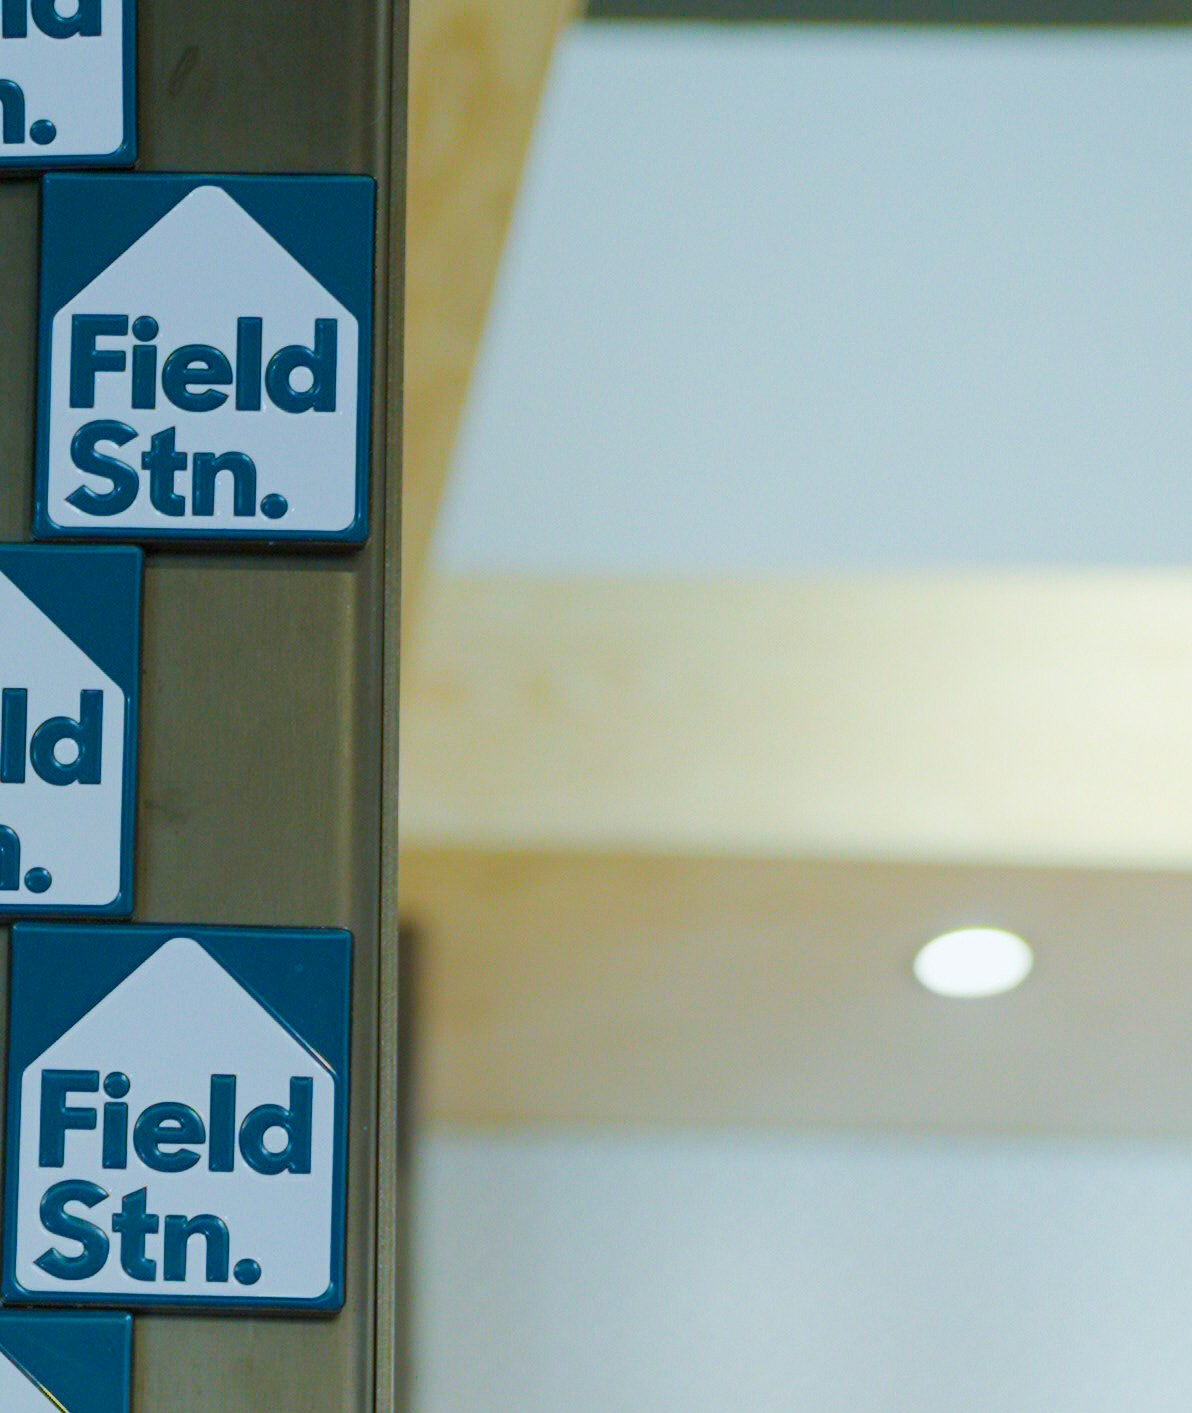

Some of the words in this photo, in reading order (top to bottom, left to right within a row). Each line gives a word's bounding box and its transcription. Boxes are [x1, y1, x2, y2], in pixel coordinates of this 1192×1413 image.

[70, 314, 337, 414] Field
[65, 420, 288, 519] Stn.
[39, 1069, 313, 1175] Field
[34, 1179, 261, 1285] Stn.
